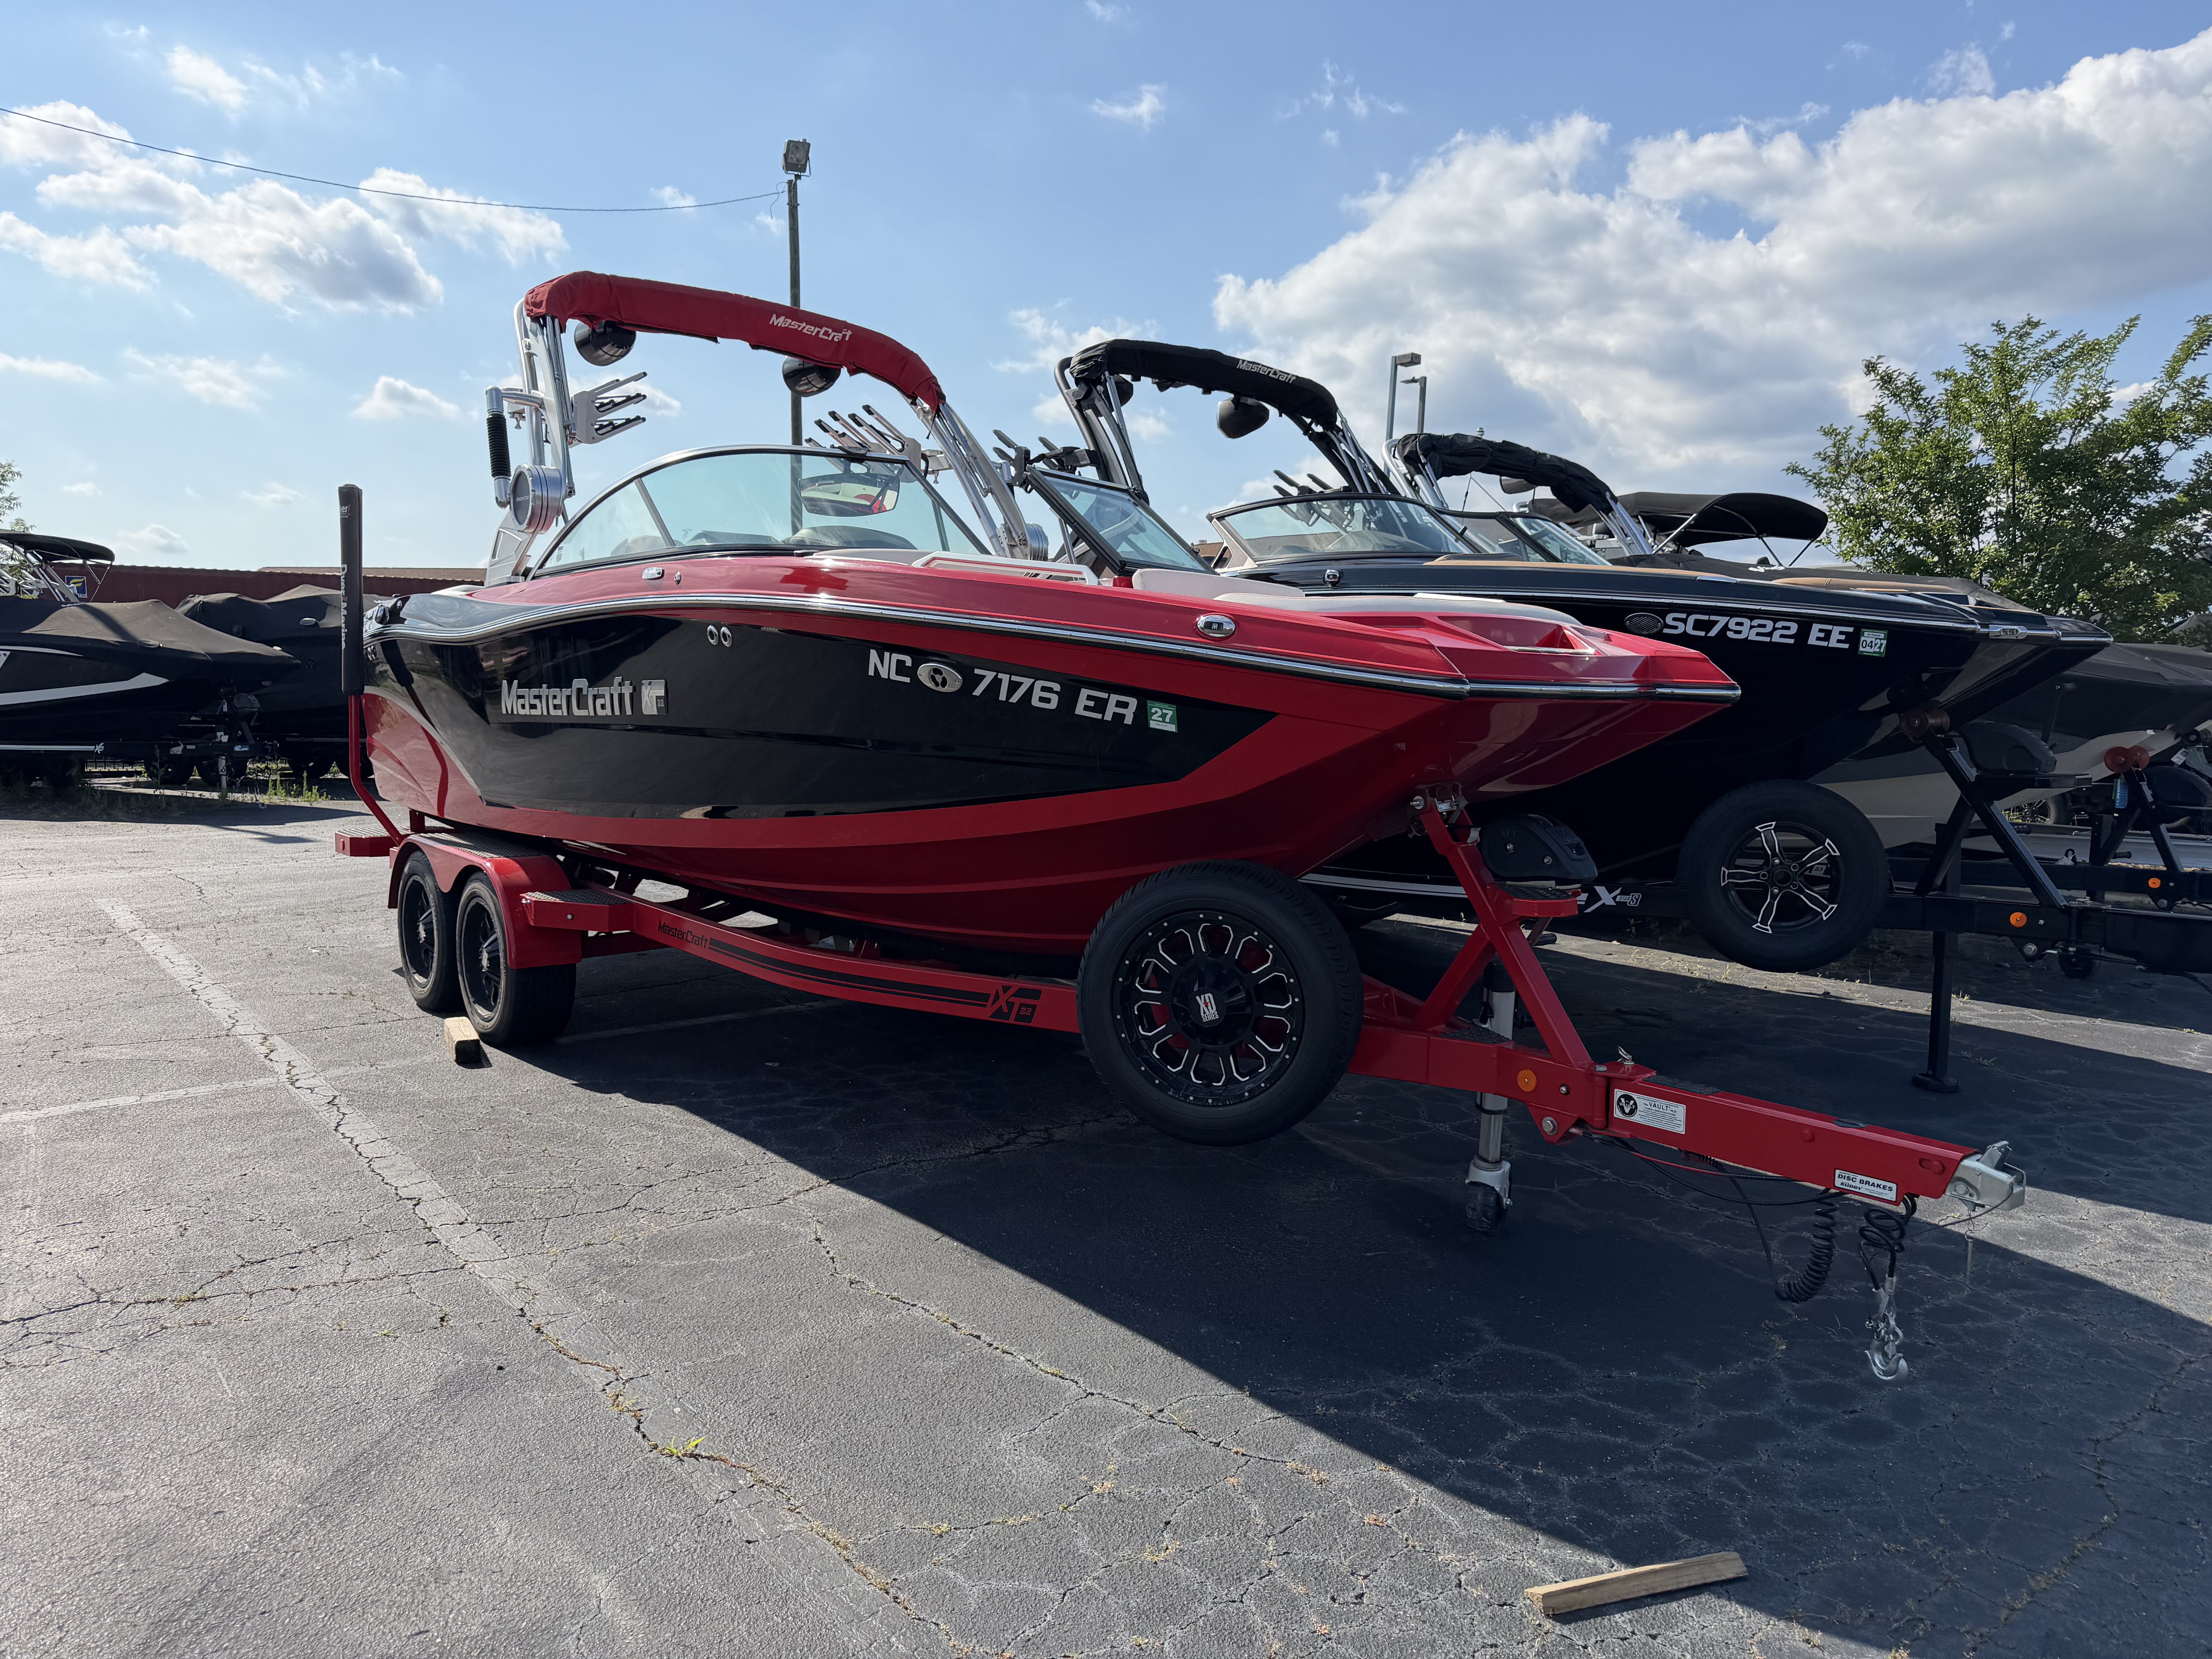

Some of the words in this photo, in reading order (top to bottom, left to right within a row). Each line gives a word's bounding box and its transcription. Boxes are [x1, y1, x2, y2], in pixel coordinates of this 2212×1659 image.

[769, 314, 852, 342] MasterCraft
[1237, 359, 1296, 384] MasterCraft
[1662, 613, 1798, 644] SC7922
[1808, 623, 1854, 649] EE
[1861, 639, 1874, 649] 04
[1874, 639, 1887, 652] 27
[501, 676, 635, 716] MasterCraft
[868, 649, 912, 683] NC
[972, 668, 1061, 710] 7176
[1074, 688, 1138, 725] ER
[1151, 708, 1173, 723] 27
[658, 919, 709, 949] MasterCraft
[1020, 1007, 1032, 1015] 22
[1202, 1011, 1219, 1022] SERIES
[1649, 1102, 1669, 1111] VAULT
[1838, 1173, 1857, 1182] DISC
[1859, 1178, 1893, 1192] BRAKES
[1840, 1182, 1863, 1190] BUDDY
